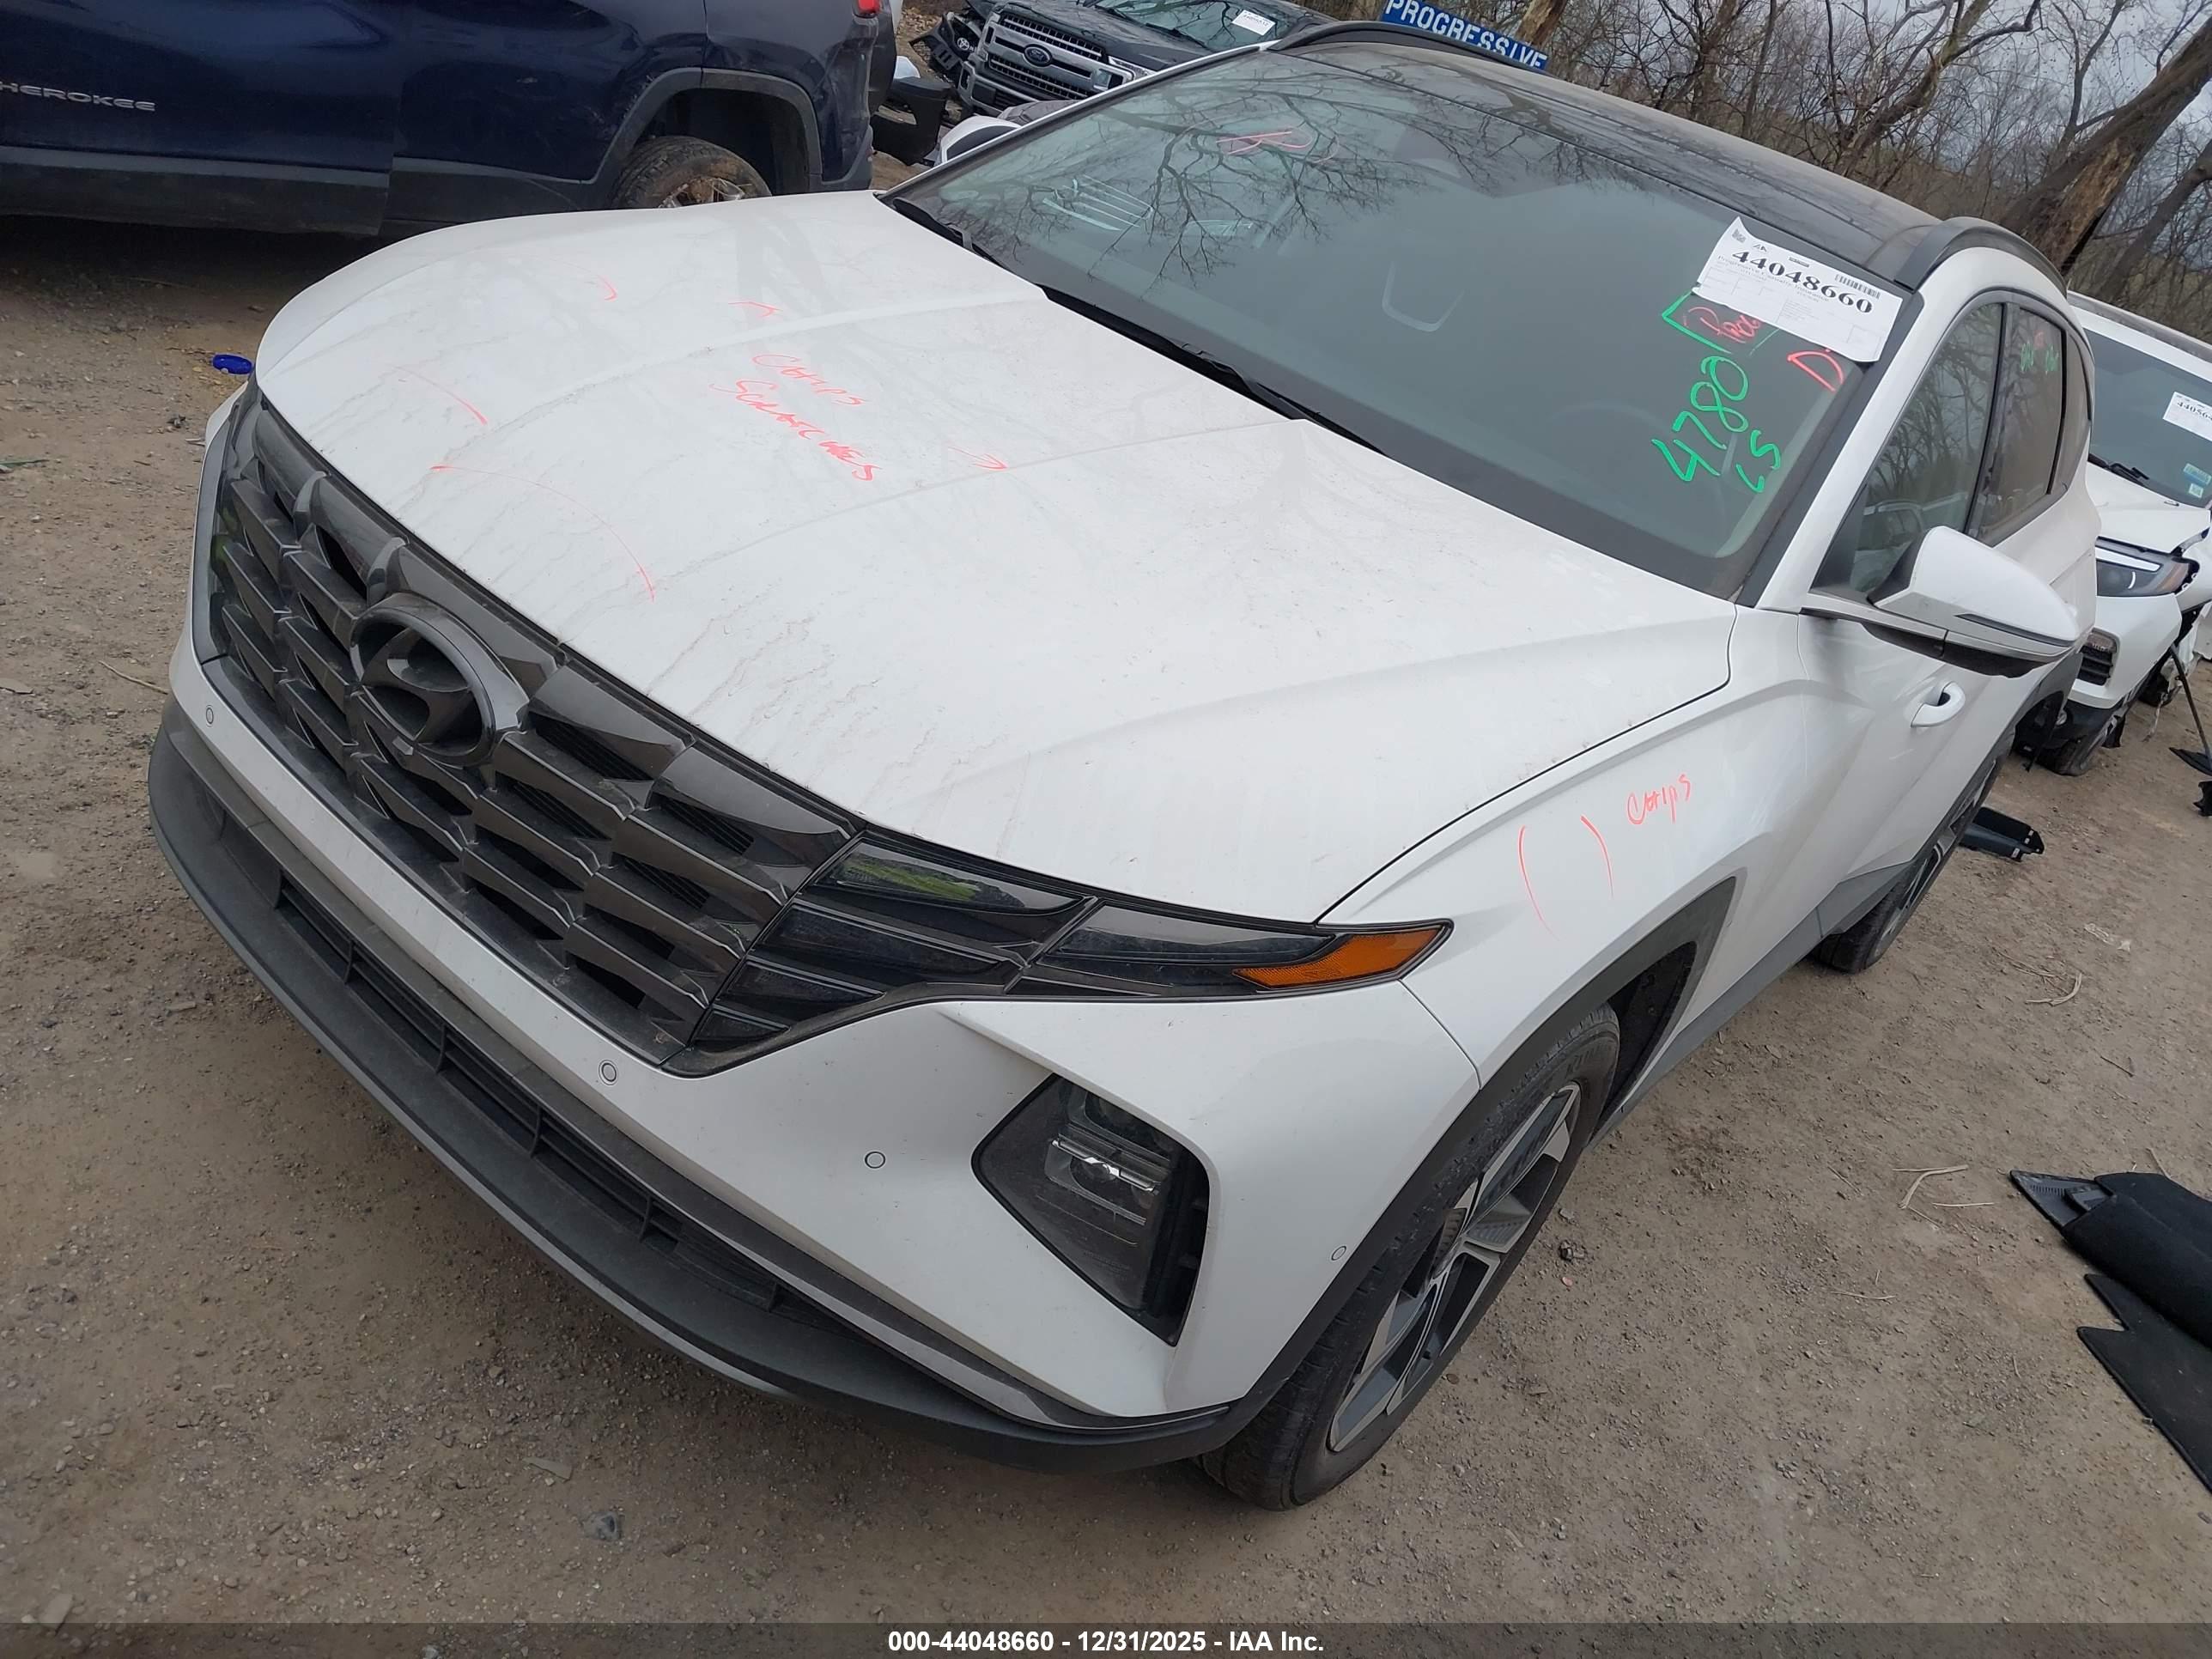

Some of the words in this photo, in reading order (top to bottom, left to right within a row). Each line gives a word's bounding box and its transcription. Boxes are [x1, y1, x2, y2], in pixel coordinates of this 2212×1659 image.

[1385, 0, 1547, 67] PROGRESSIVE
[1732, 251, 1873, 313] 44048660
[1650, 355, 1750, 483] 4780
